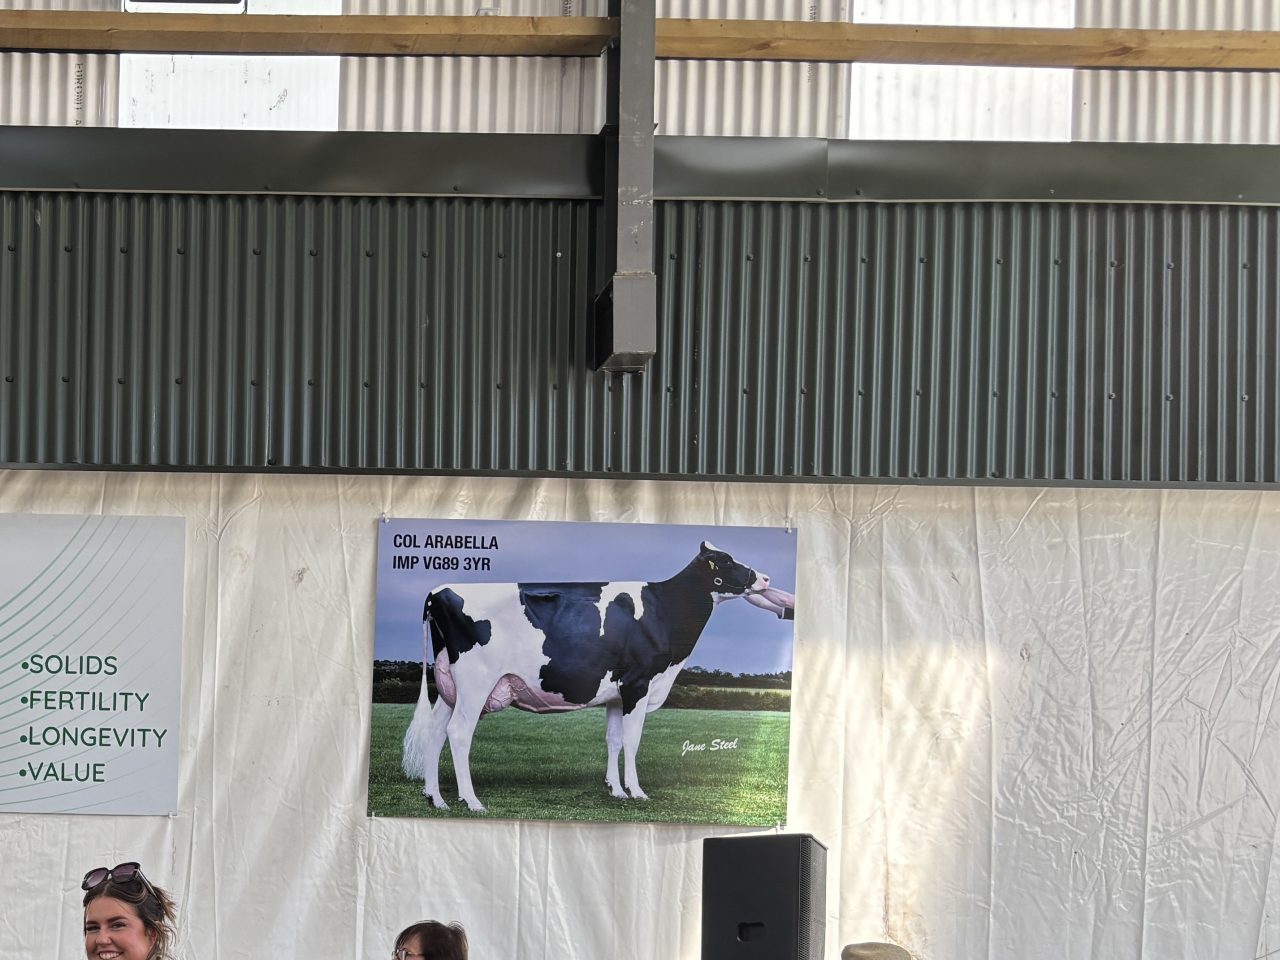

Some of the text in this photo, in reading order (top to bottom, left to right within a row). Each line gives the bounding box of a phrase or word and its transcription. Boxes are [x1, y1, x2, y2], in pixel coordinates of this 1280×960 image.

[393, 534, 499, 550] COL ARABELLA
[392, 555, 491, 571] IMP VG89 3YR
[28, 654, 118, 675] SOLIDS
[28, 690, 150, 712] FERTILITY
[28, 726, 168, 748] LONGEVITY
[681, 737, 739, 757] Jane Steel
[27, 761, 106, 783] VALUE
